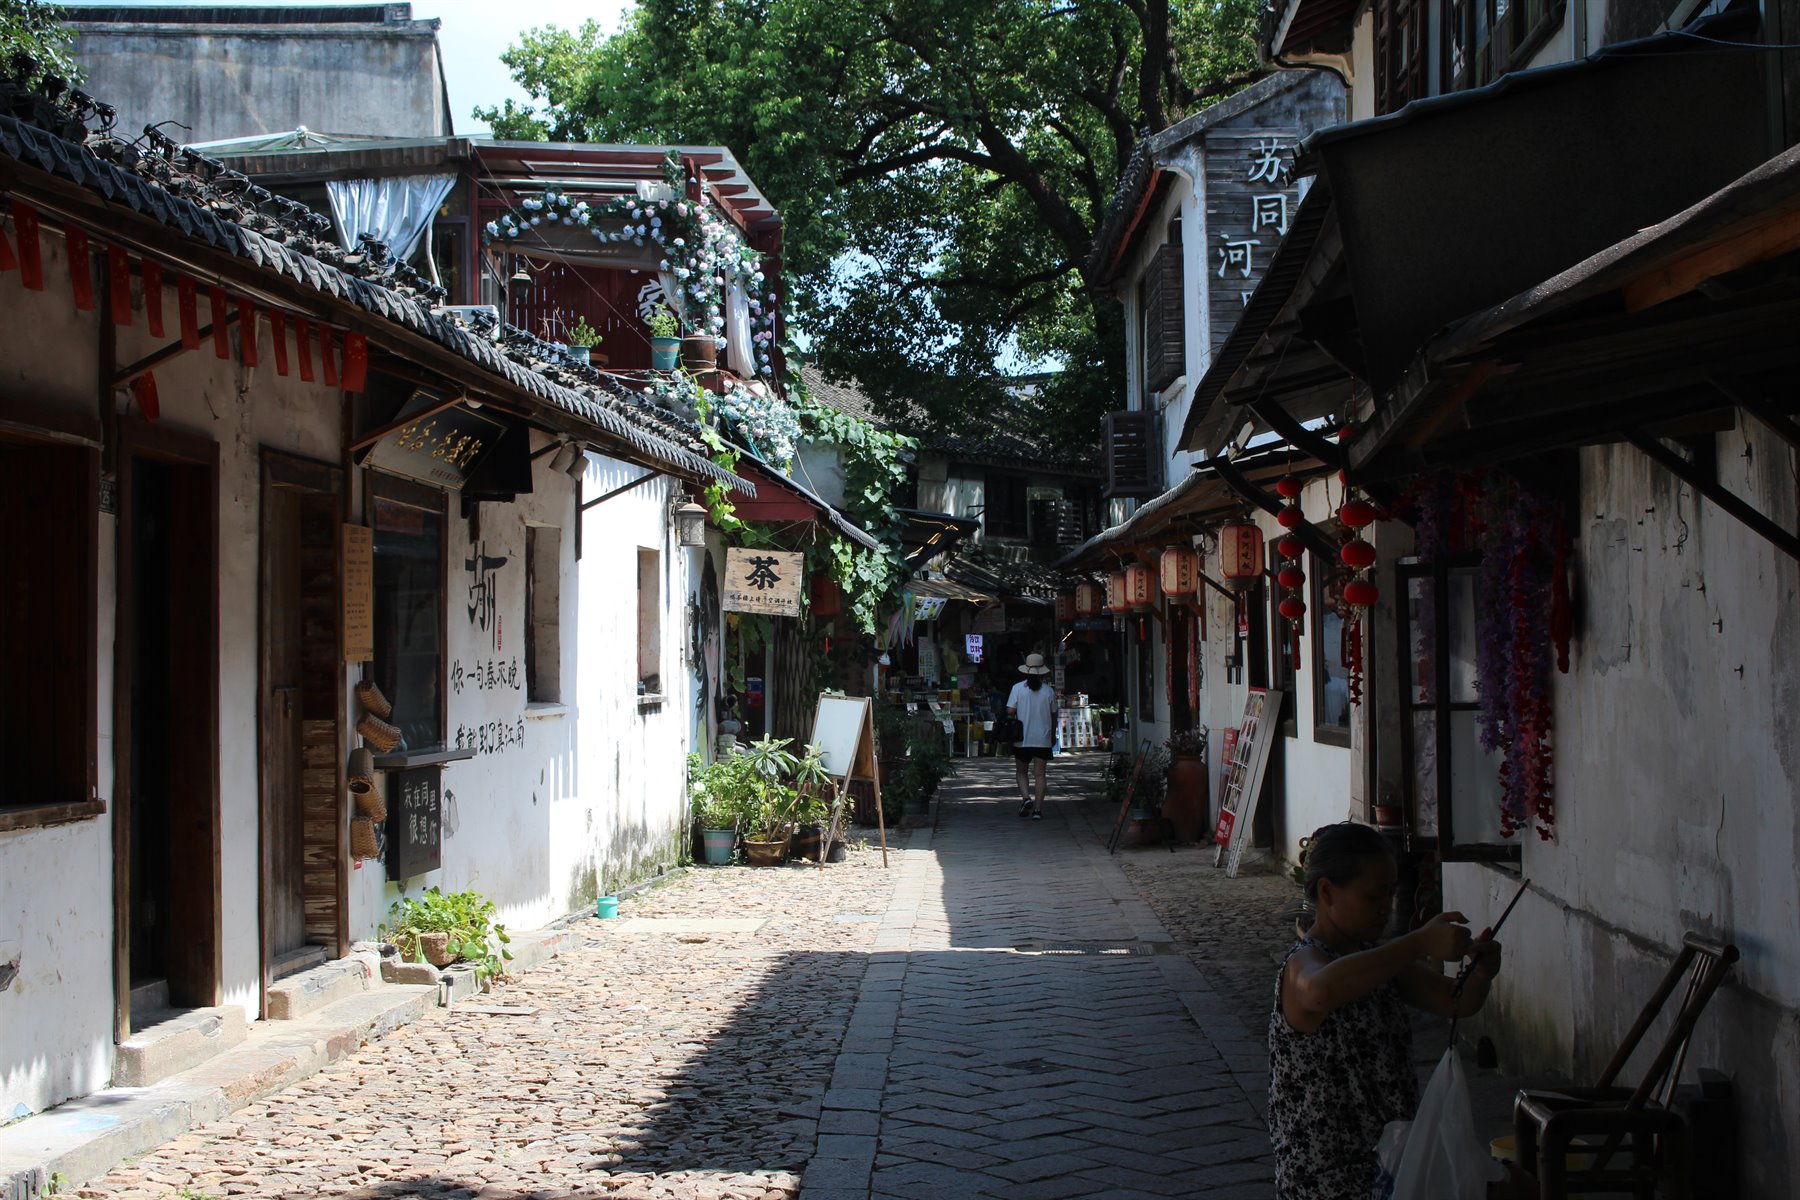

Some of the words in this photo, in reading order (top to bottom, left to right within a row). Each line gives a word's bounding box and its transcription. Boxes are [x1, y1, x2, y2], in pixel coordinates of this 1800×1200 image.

[744, 556, 782, 591] 茶
[451, 656, 521, 695] 你一句春不晚
[403, 780, 437, 812] 我在同里
[408, 813, 438, 846] 很想你
